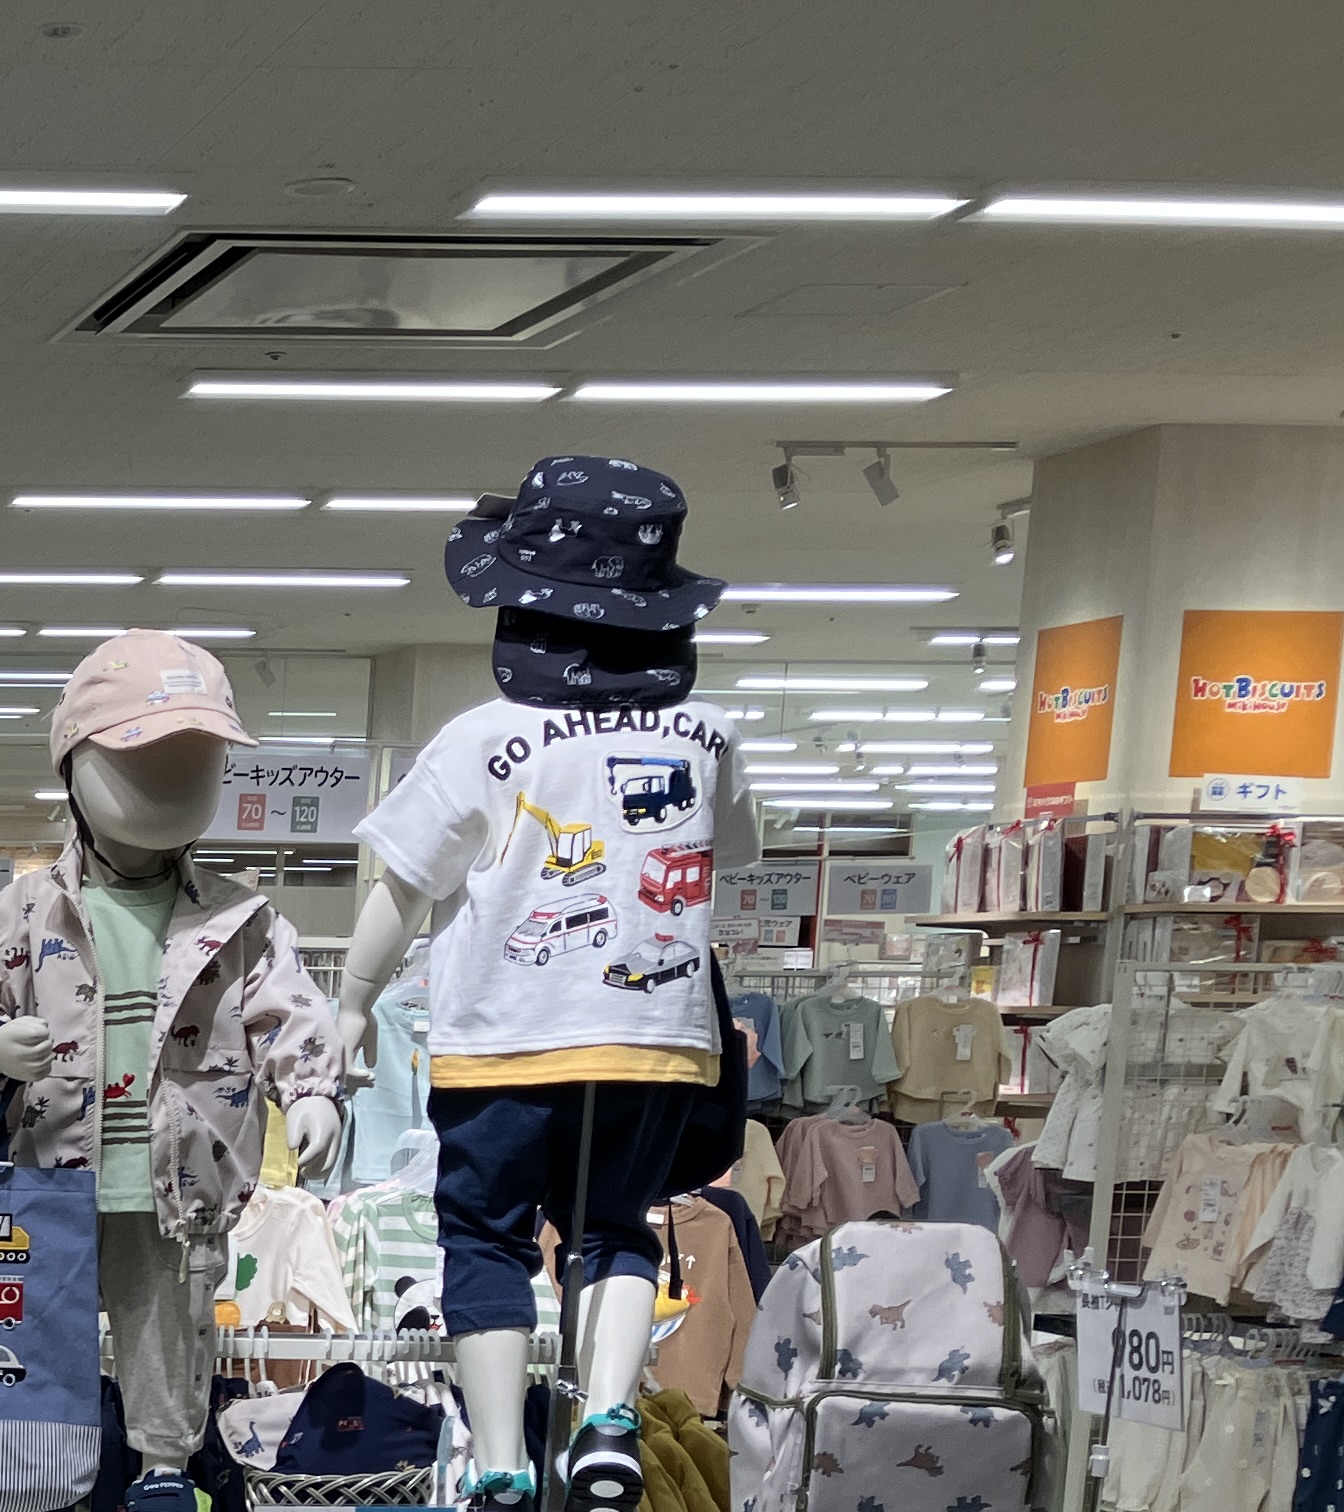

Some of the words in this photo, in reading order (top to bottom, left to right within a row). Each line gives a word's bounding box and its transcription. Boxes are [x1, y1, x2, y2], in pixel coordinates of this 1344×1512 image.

[488, 736, 531, 781] GO
[223, 754, 361, 788] ビーキッズアウター
[1236, 783, 1287, 800] ギフト
[242, 804, 262, 819] 70
[294, 806, 317, 822] 120
[719, 872, 811, 886] ベビーキッズアウター
[844, 872, 916, 885] ベビーウェア
[742, 894, 756, 905] 70
